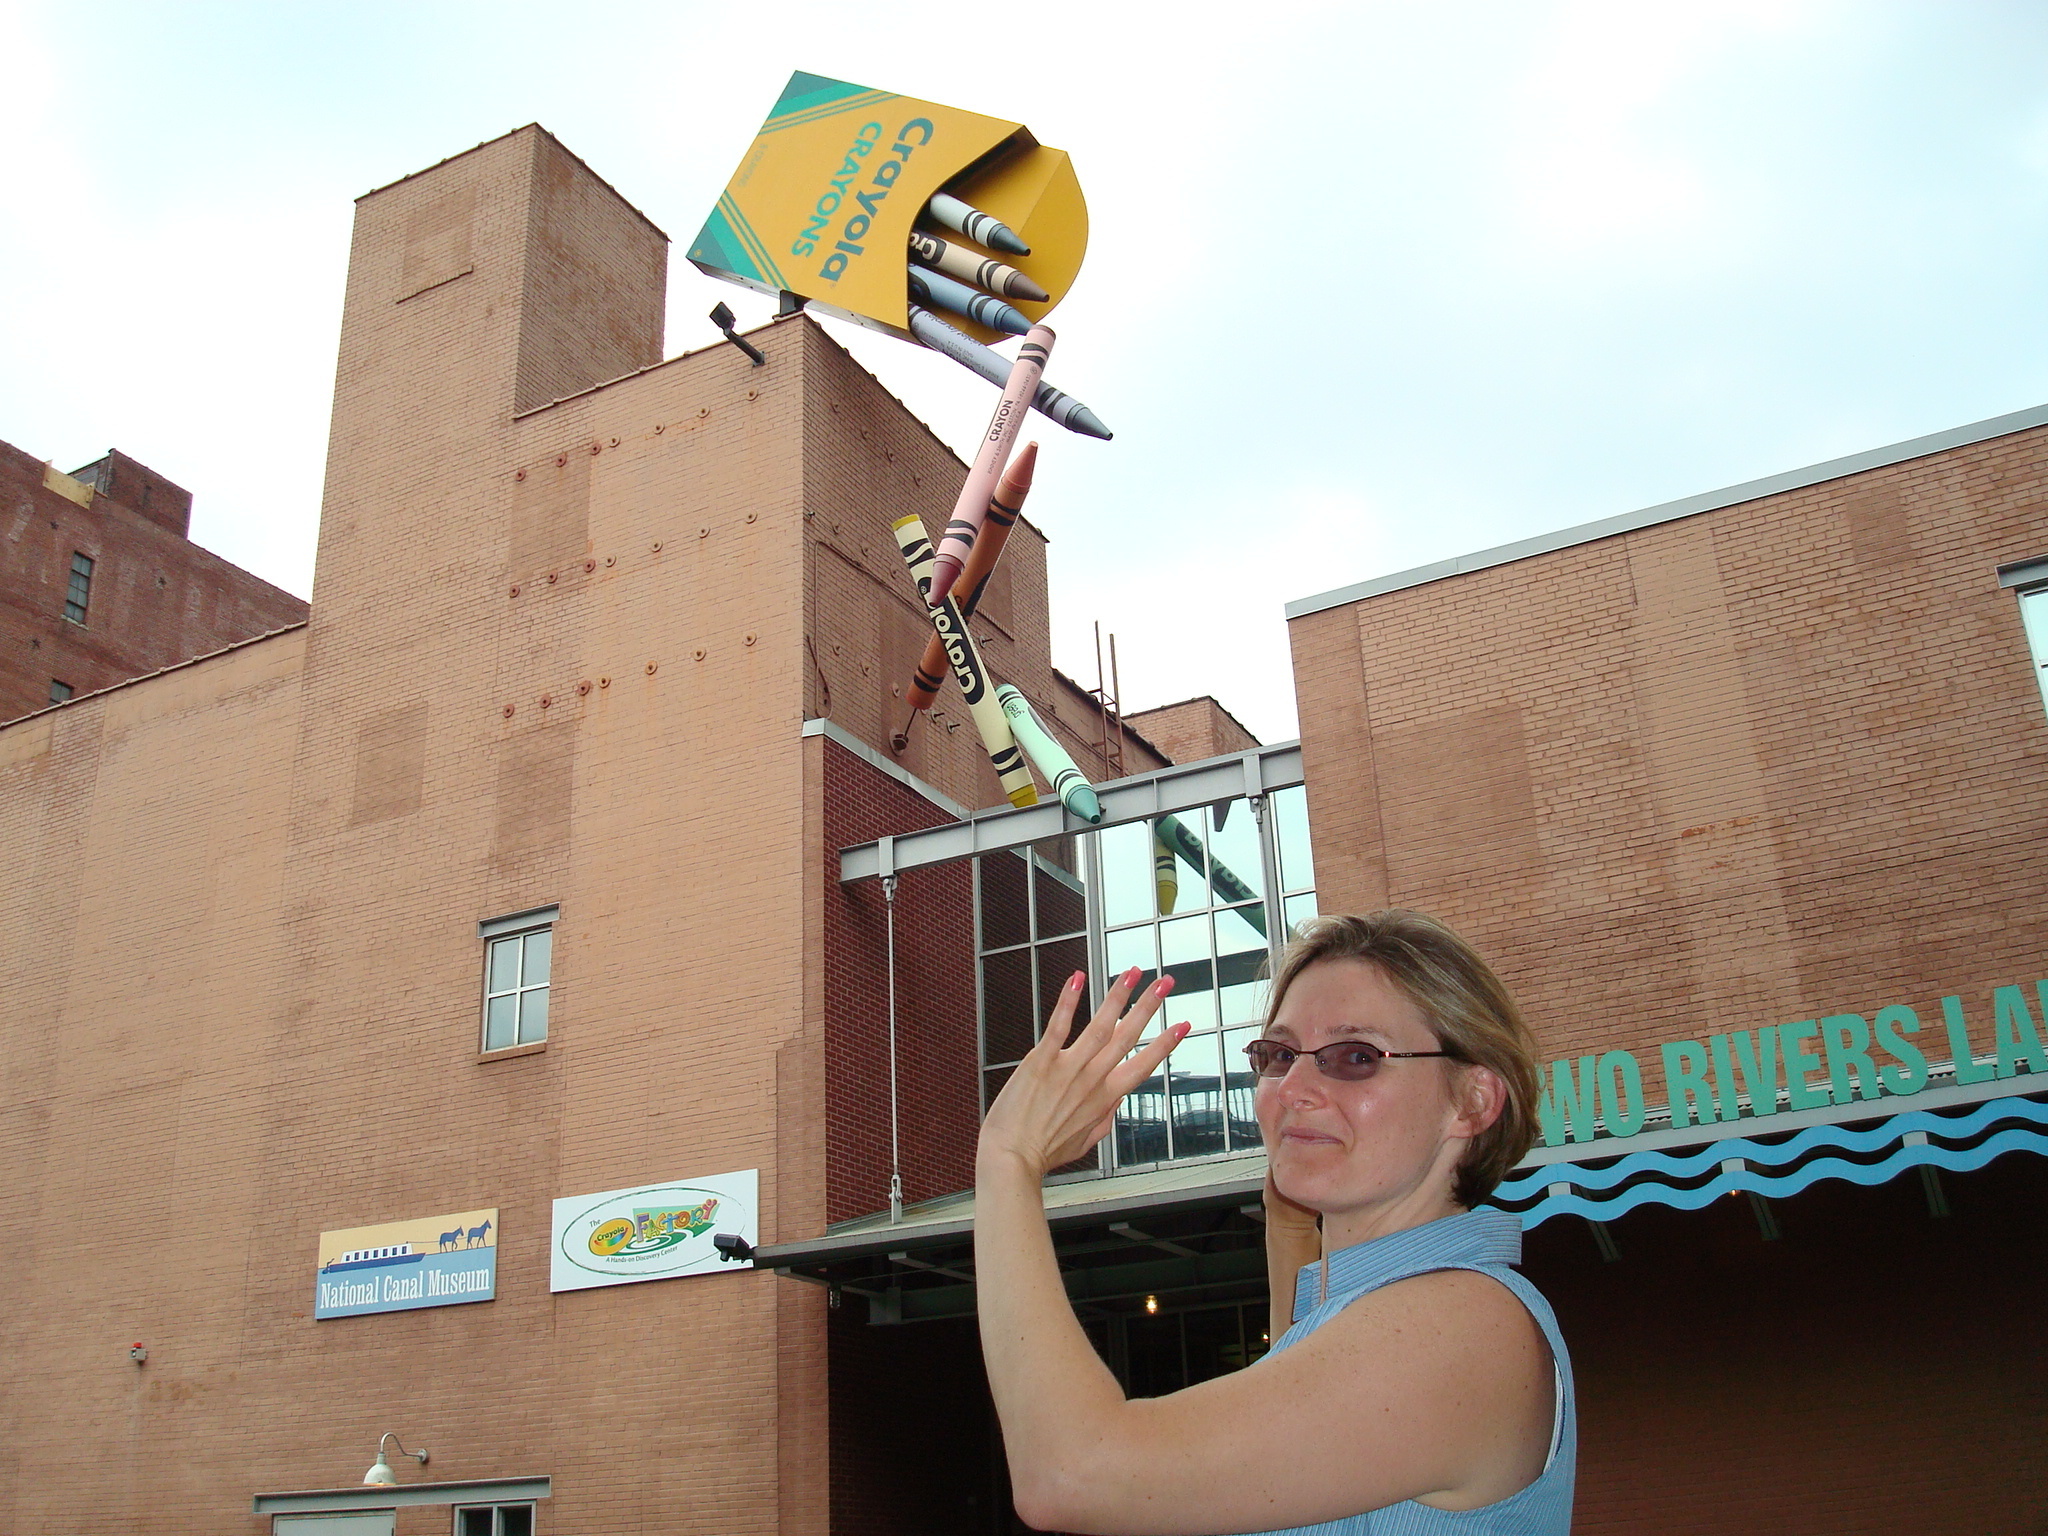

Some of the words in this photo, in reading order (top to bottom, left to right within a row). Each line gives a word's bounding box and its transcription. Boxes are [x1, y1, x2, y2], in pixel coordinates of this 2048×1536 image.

[791, 121, 883, 258] CRAYONS
[818, 118, 934, 282] Crayola
[989, 400, 1013, 441] CRAYON
[1007, 701, 1025, 719] green
[1535, 1049, 1646, 1148] WO
[1661, 1004, 1928, 1129] RIVERS
[589, 1219, 601, 1228] The
[596, 1225, 626, 1242] Crayola
[636, 1199, 718, 1243] FACTORY
[636, 1252, 661, 1263] Discovery
[661, 1245, 678, 1256] Center
[320, 1275, 380, 1309] National
[383, 1270, 424, 1302] Canal
[427, 1267, 490, 1297] Museum
